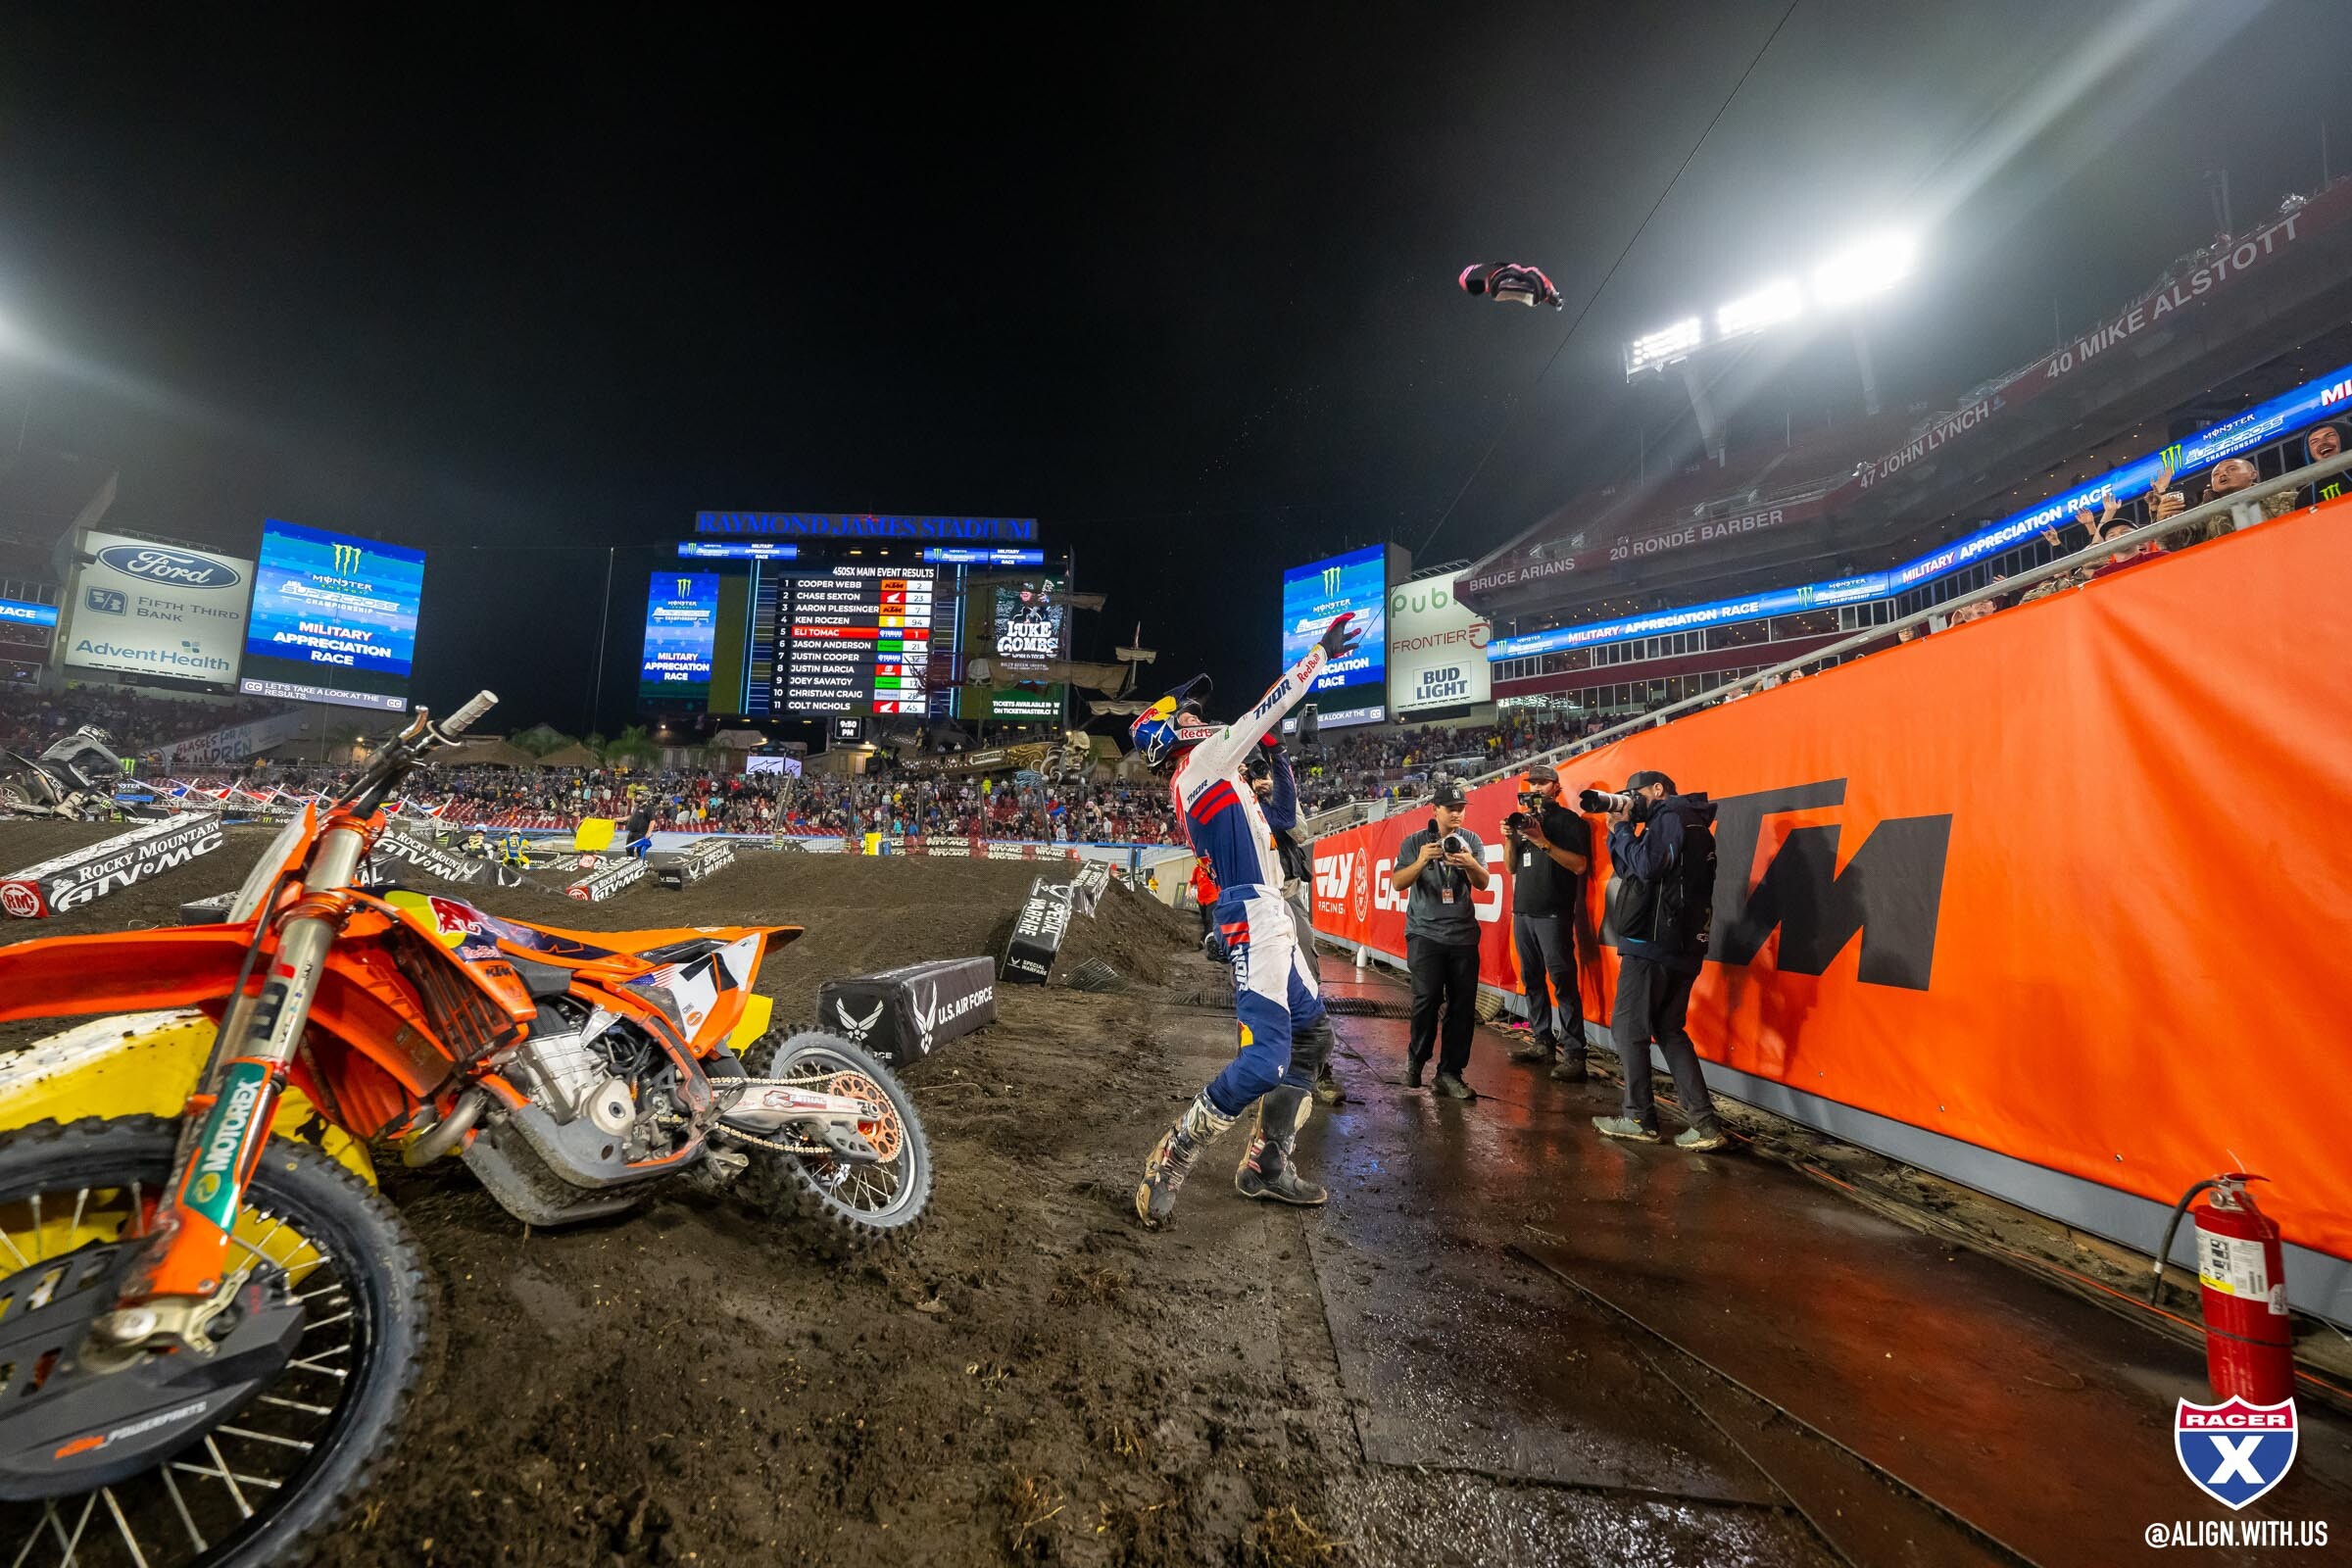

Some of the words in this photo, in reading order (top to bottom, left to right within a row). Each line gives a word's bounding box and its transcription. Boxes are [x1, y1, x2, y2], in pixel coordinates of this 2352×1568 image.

[2046, 352, 2073, 377] 40
[2080, 308, 2145, 362] MIKE
[2153, 212, 2301, 318] ALSTOTT
[1860, 468, 1878, 488] 47
[1880, 438, 1925, 480] JOHN
[1928, 405, 1989, 452] LYNCH
[2206, 435, 2262, 463] CHAMPIONSHIP
[699, 514, 829, 534] RAYMOND
[834, 515, 916, 536] JAMES
[921, 517, 1031, 538] STADIUM
[1610, 546, 1629, 562] 20
[1632, 526, 1694, 556] RONDÉ
[1700, 510, 1784, 540] BARBER
[1902, 551, 1954, 584] MILITARY
[1959, 507, 2063, 561] APPRECIATION
[2067, 483, 2112, 514] RACE
[127, 550, 214, 585] Ford
[833, 566, 856, 576] 450SX
[857, 567, 876, 576] MAIN
[877, 567, 901, 577] EVENT
[903, 568, 934, 578] RESULTS
[1469, 570, 1516, 592] BRUCE
[1520, 558, 1575, 581] ARIANS
[137, 609, 182, 622] BANK
[138, 596, 184, 612] FIFTH
[190, 605, 239, 620] THIRD
[306, 599, 373, 614] CHAMPIONSHIP
[299, 621, 372, 641] MILITARY
[1007, 620, 1052, 637] LUKE
[1568, 625, 1620, 643] MILITARY
[1625, 609, 1717, 633] APPRECIATION
[1722, 602, 1759, 617] RACE
[273, 632, 391, 658] APPRECIATION
[1393, 629, 1467, 654] FRONTIER
[311, 651, 354, 665] RACE
[645, 662, 710, 671] APPRECIATION
[1318, 677, 1345, 689] RACE
[1424, 666, 1460, 684] BUD
[266, 683, 290, 692] LET'S
[324, 689, 349, 698] LOOK
[266, 689, 308, 699] RESULTS.
[1253, 678, 1293, 719] THOR
[1416, 680, 1468, 700] LIGHT
[1329, 712, 1345, 721] LOOK
[1188, 779, 1208, 804] THOR
[78, 854, 133, 883] ROCKY
[138, 819, 220, 862] MOUNTAIN
[396, 832, 429, 855] ROCKY
[704, 845, 731, 866] SPECIAL
[599, 873, 617, 889] ROCKY
[1314, 853, 1354, 899] FLY
[5, 895, 35, 909] RMC
[1018, 898, 1047, 936] WARFARE
[1022, 964, 1047, 976] WARFARE
[1023, 960, 1045, 969] SPECIAL
[939, 1004, 955, 1024] U.S.
[956, 997, 969, 1016] AIR
[969, 986, 993, 1010] FORCE
[201, 1077, 263, 1173] MOTOREX
